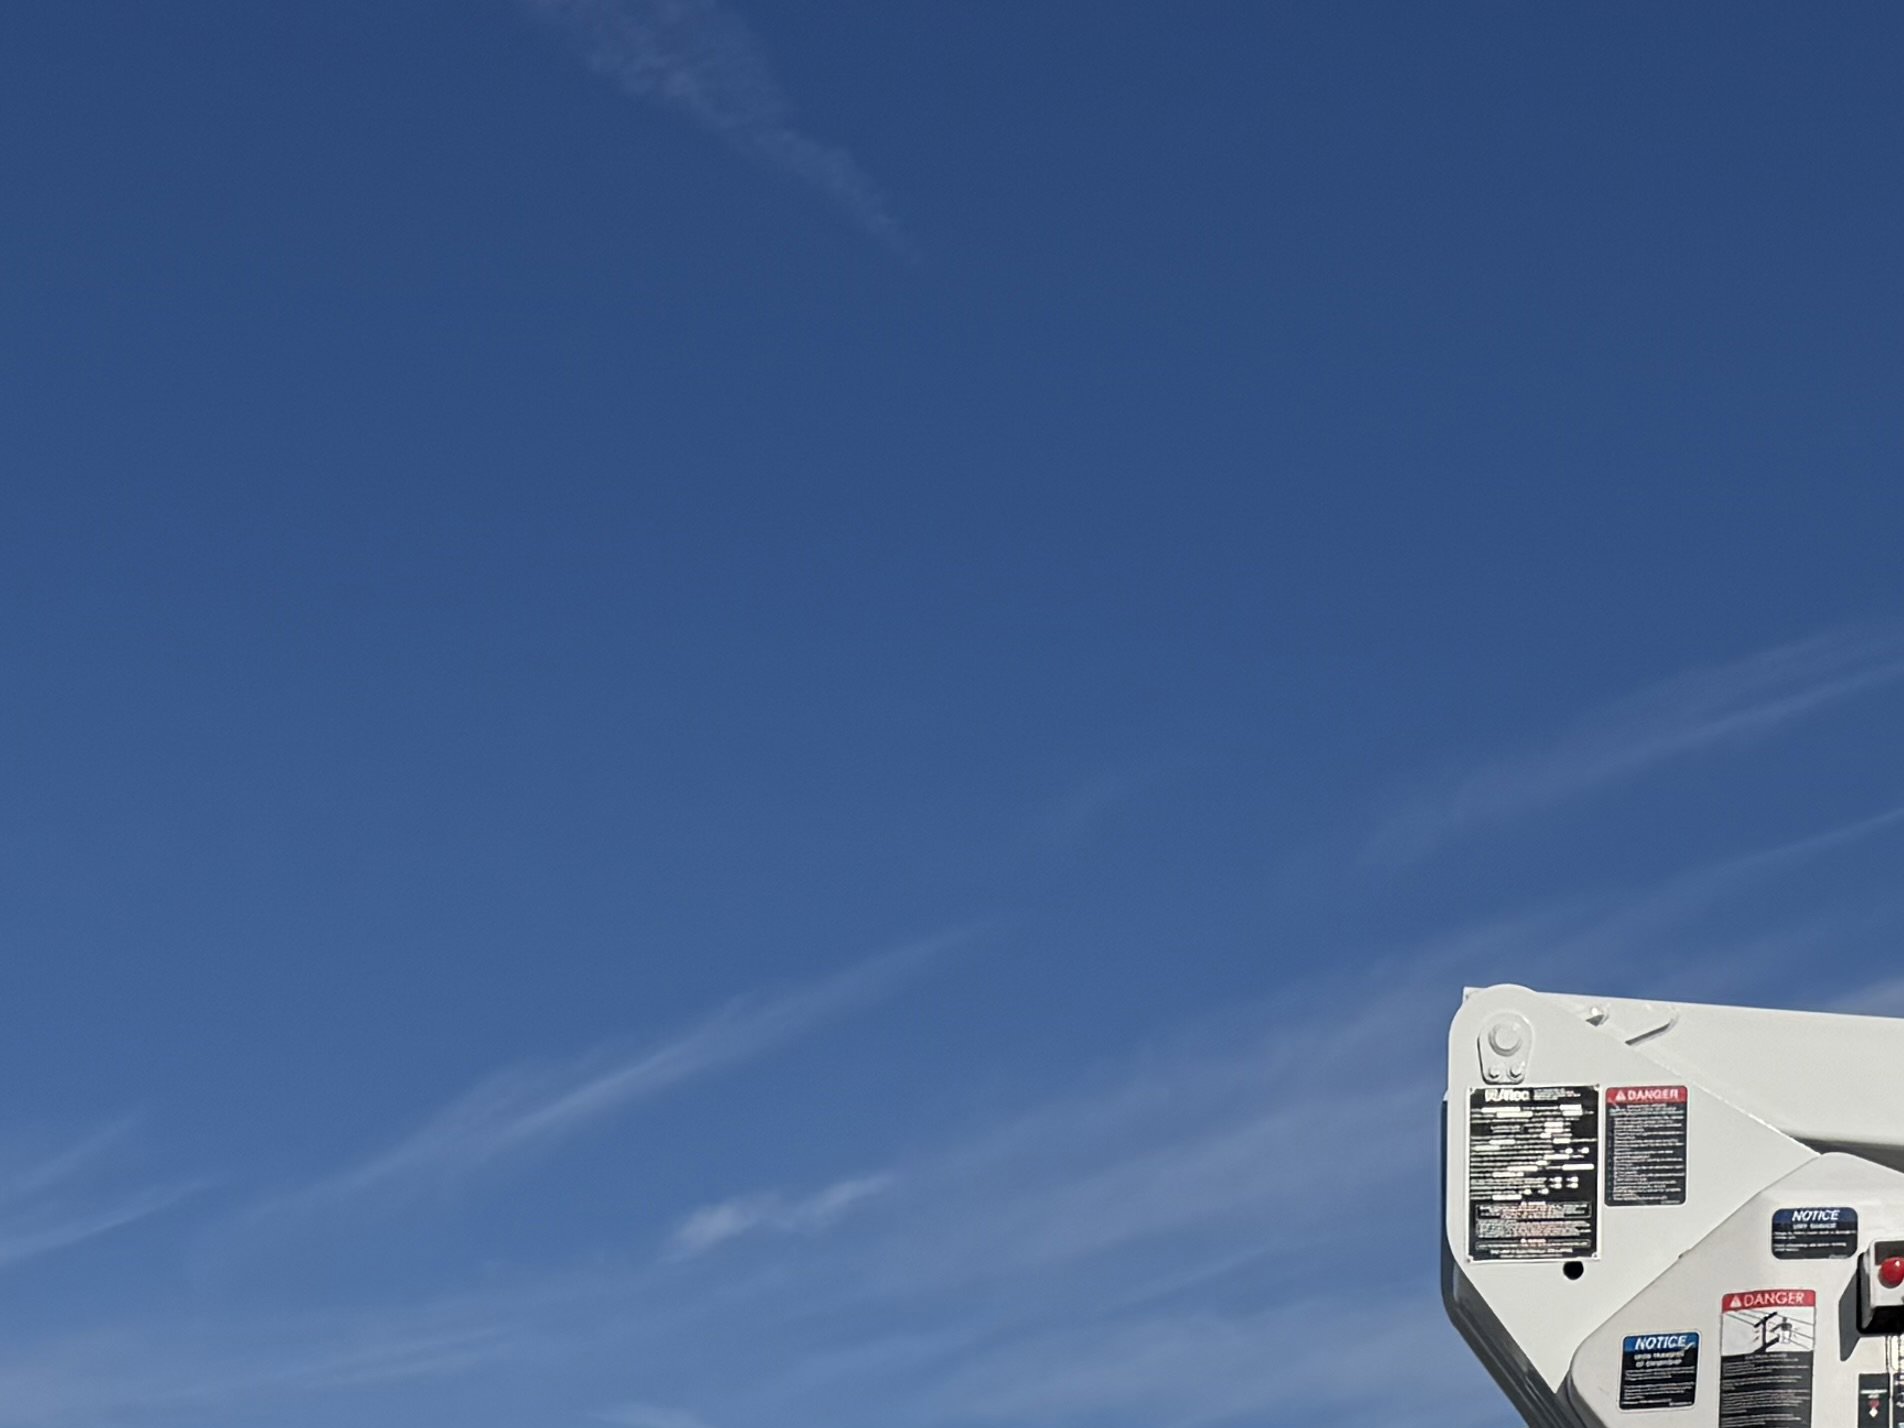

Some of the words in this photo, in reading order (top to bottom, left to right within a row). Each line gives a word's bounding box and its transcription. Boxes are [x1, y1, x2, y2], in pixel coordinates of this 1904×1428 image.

[1627, 1089, 1679, 1101] DANGER
[1792, 1210, 1840, 1221] NOTICE
[1743, 1292, 1805, 1307] DANGER
[1634, 1335, 1688, 1350] NOTICE
